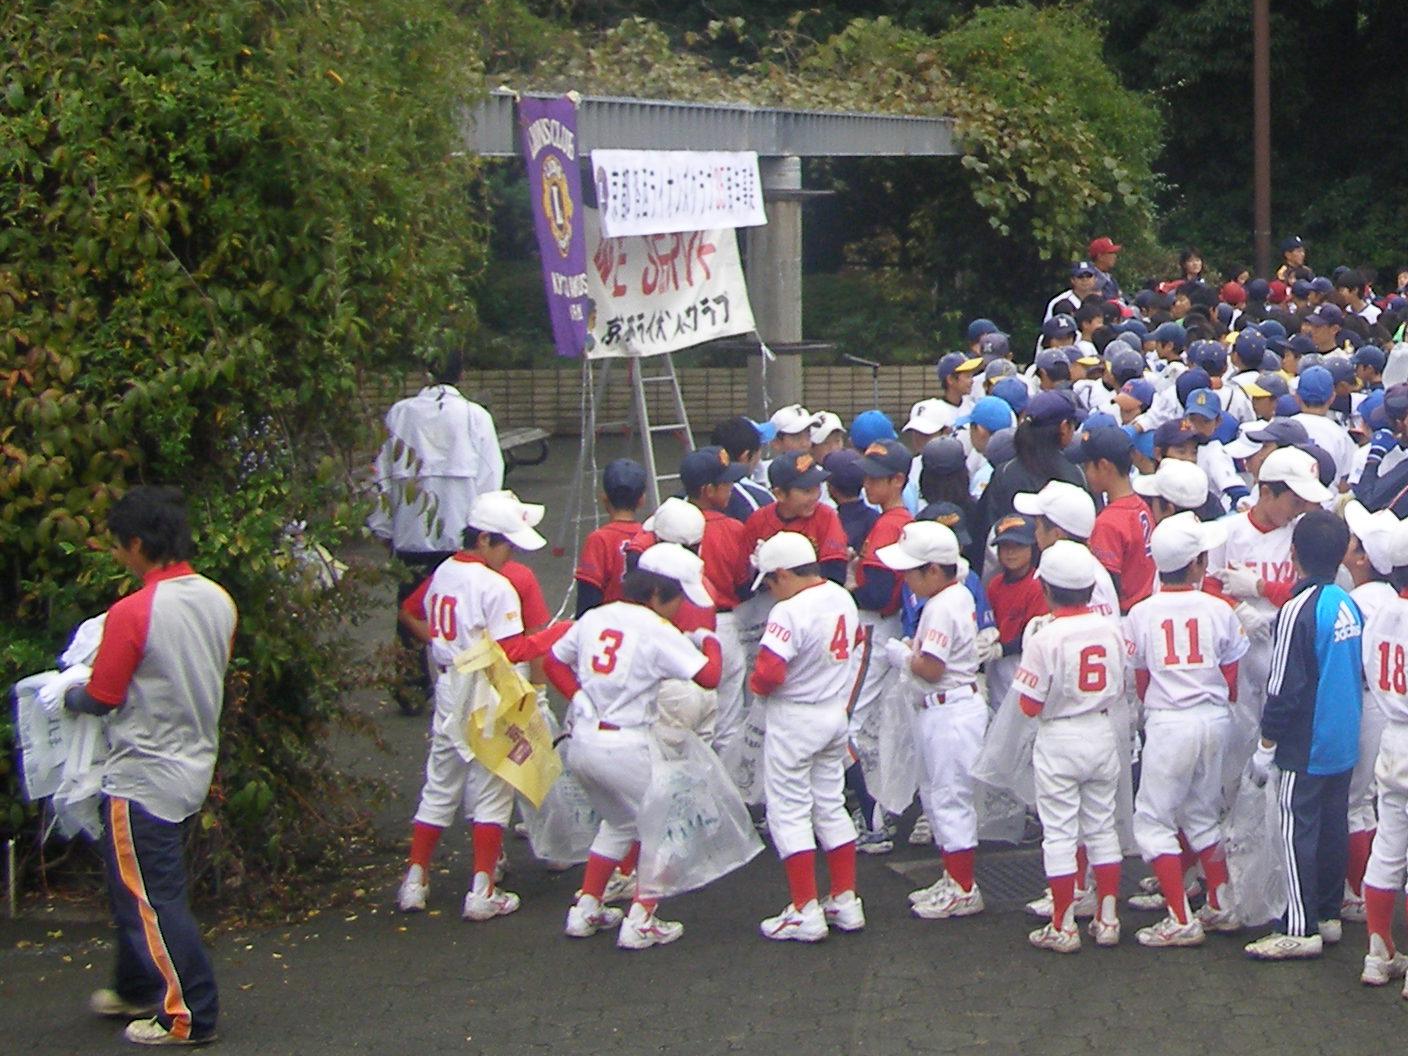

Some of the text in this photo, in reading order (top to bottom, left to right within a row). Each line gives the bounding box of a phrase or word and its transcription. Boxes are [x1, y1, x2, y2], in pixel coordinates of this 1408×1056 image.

[429, 593, 458, 642] 10
[830, 614, 850, 661] 4
[1160, 617, 1204, 666] 11
[591, 628, 625, 676] 3
[1078, 644, 1108, 693] 6
[1378, 640, 1408, 696] 18
